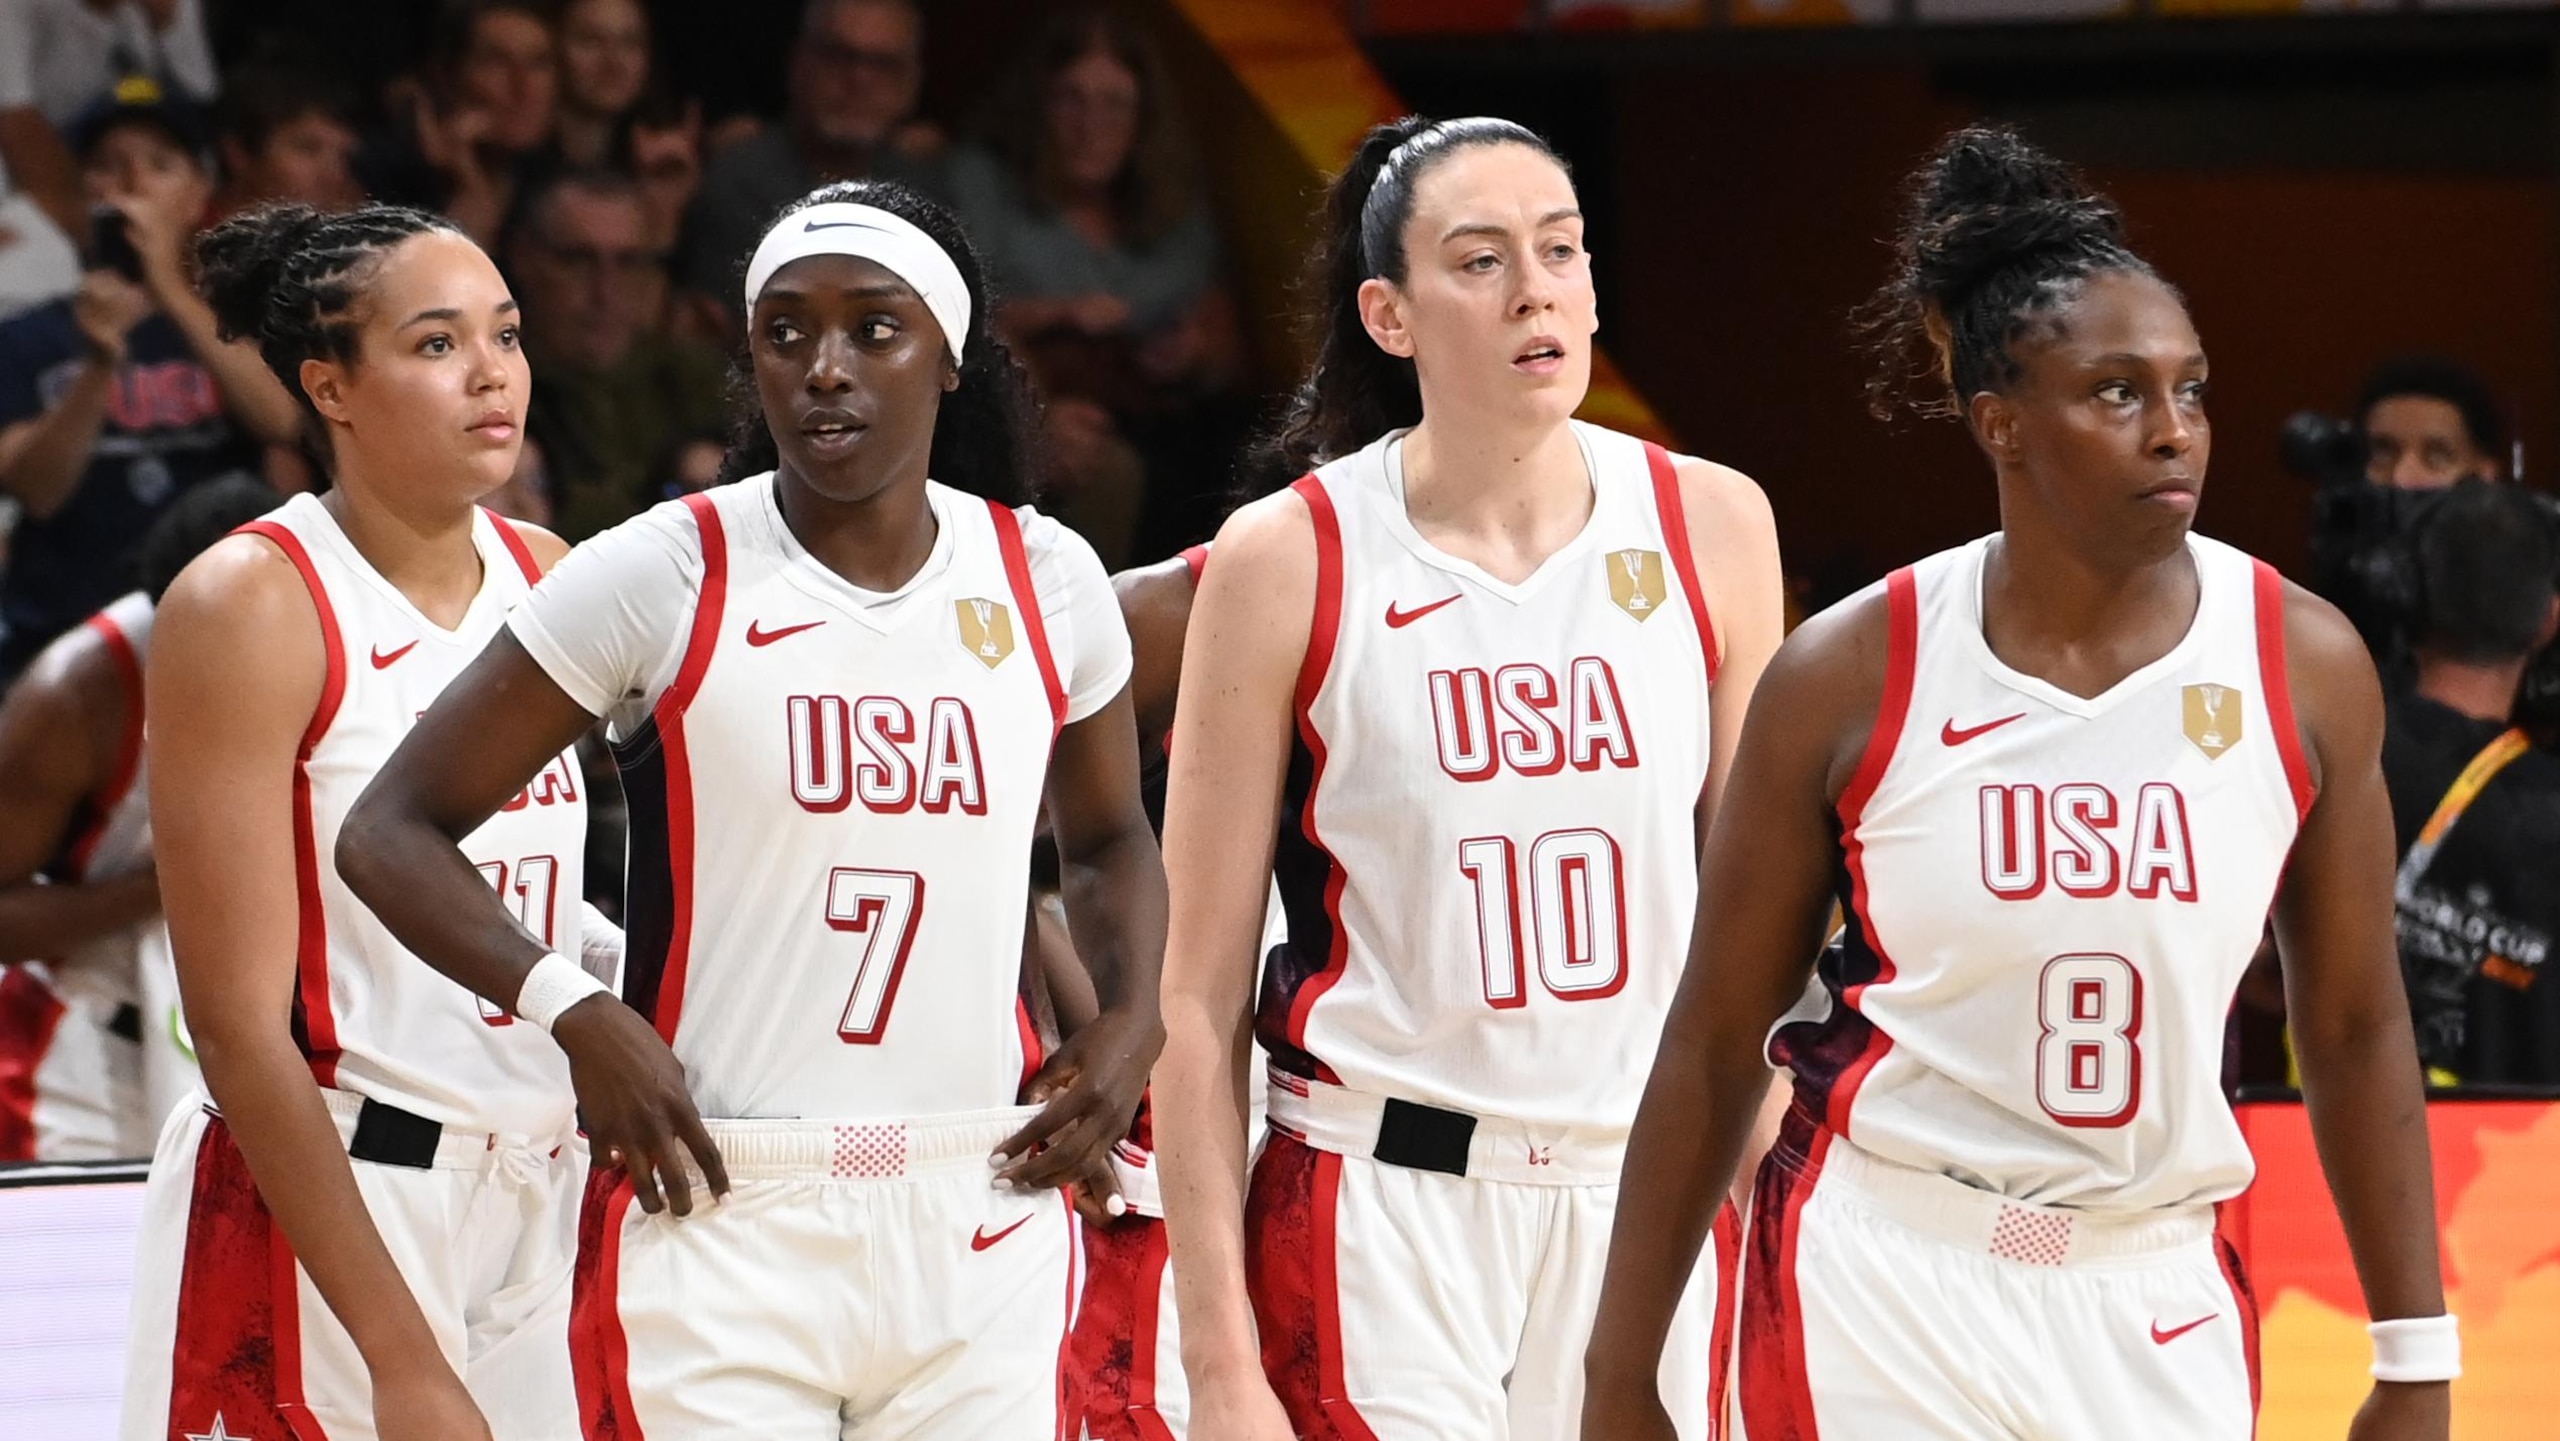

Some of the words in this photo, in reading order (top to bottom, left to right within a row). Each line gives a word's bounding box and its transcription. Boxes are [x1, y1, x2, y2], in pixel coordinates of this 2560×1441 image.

[787, 695, 987, 816] USA
[1428, 656, 1640, 783] USA
[1979, 782, 2199, 903] USA
[825, 867, 925, 1045] 7
[1459, 827, 1629, 1010] 10
[2036, 952, 2143, 1128] 8
